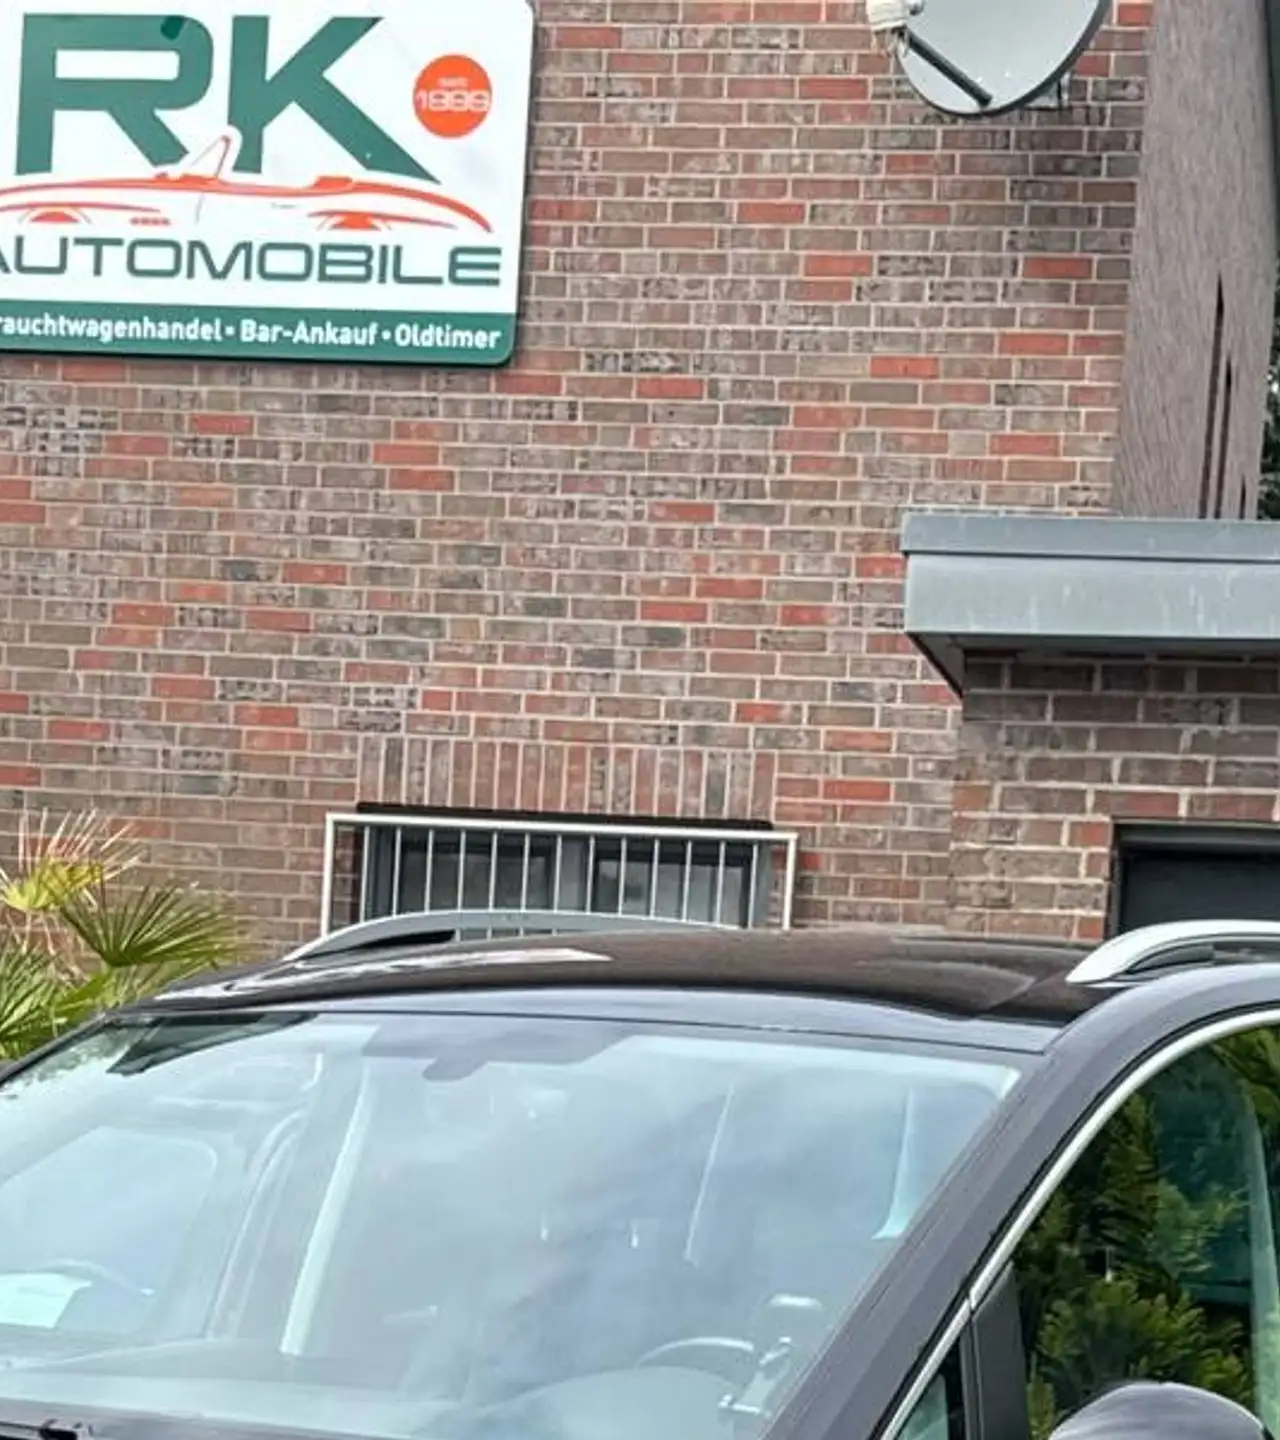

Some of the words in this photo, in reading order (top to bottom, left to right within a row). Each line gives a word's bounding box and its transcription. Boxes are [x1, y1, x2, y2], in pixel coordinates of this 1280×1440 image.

[15, 13, 442, 185] RK
[240, 319, 378, 346] Bar-Ankauf
[395, 324, 501, 350] Oldtimer
